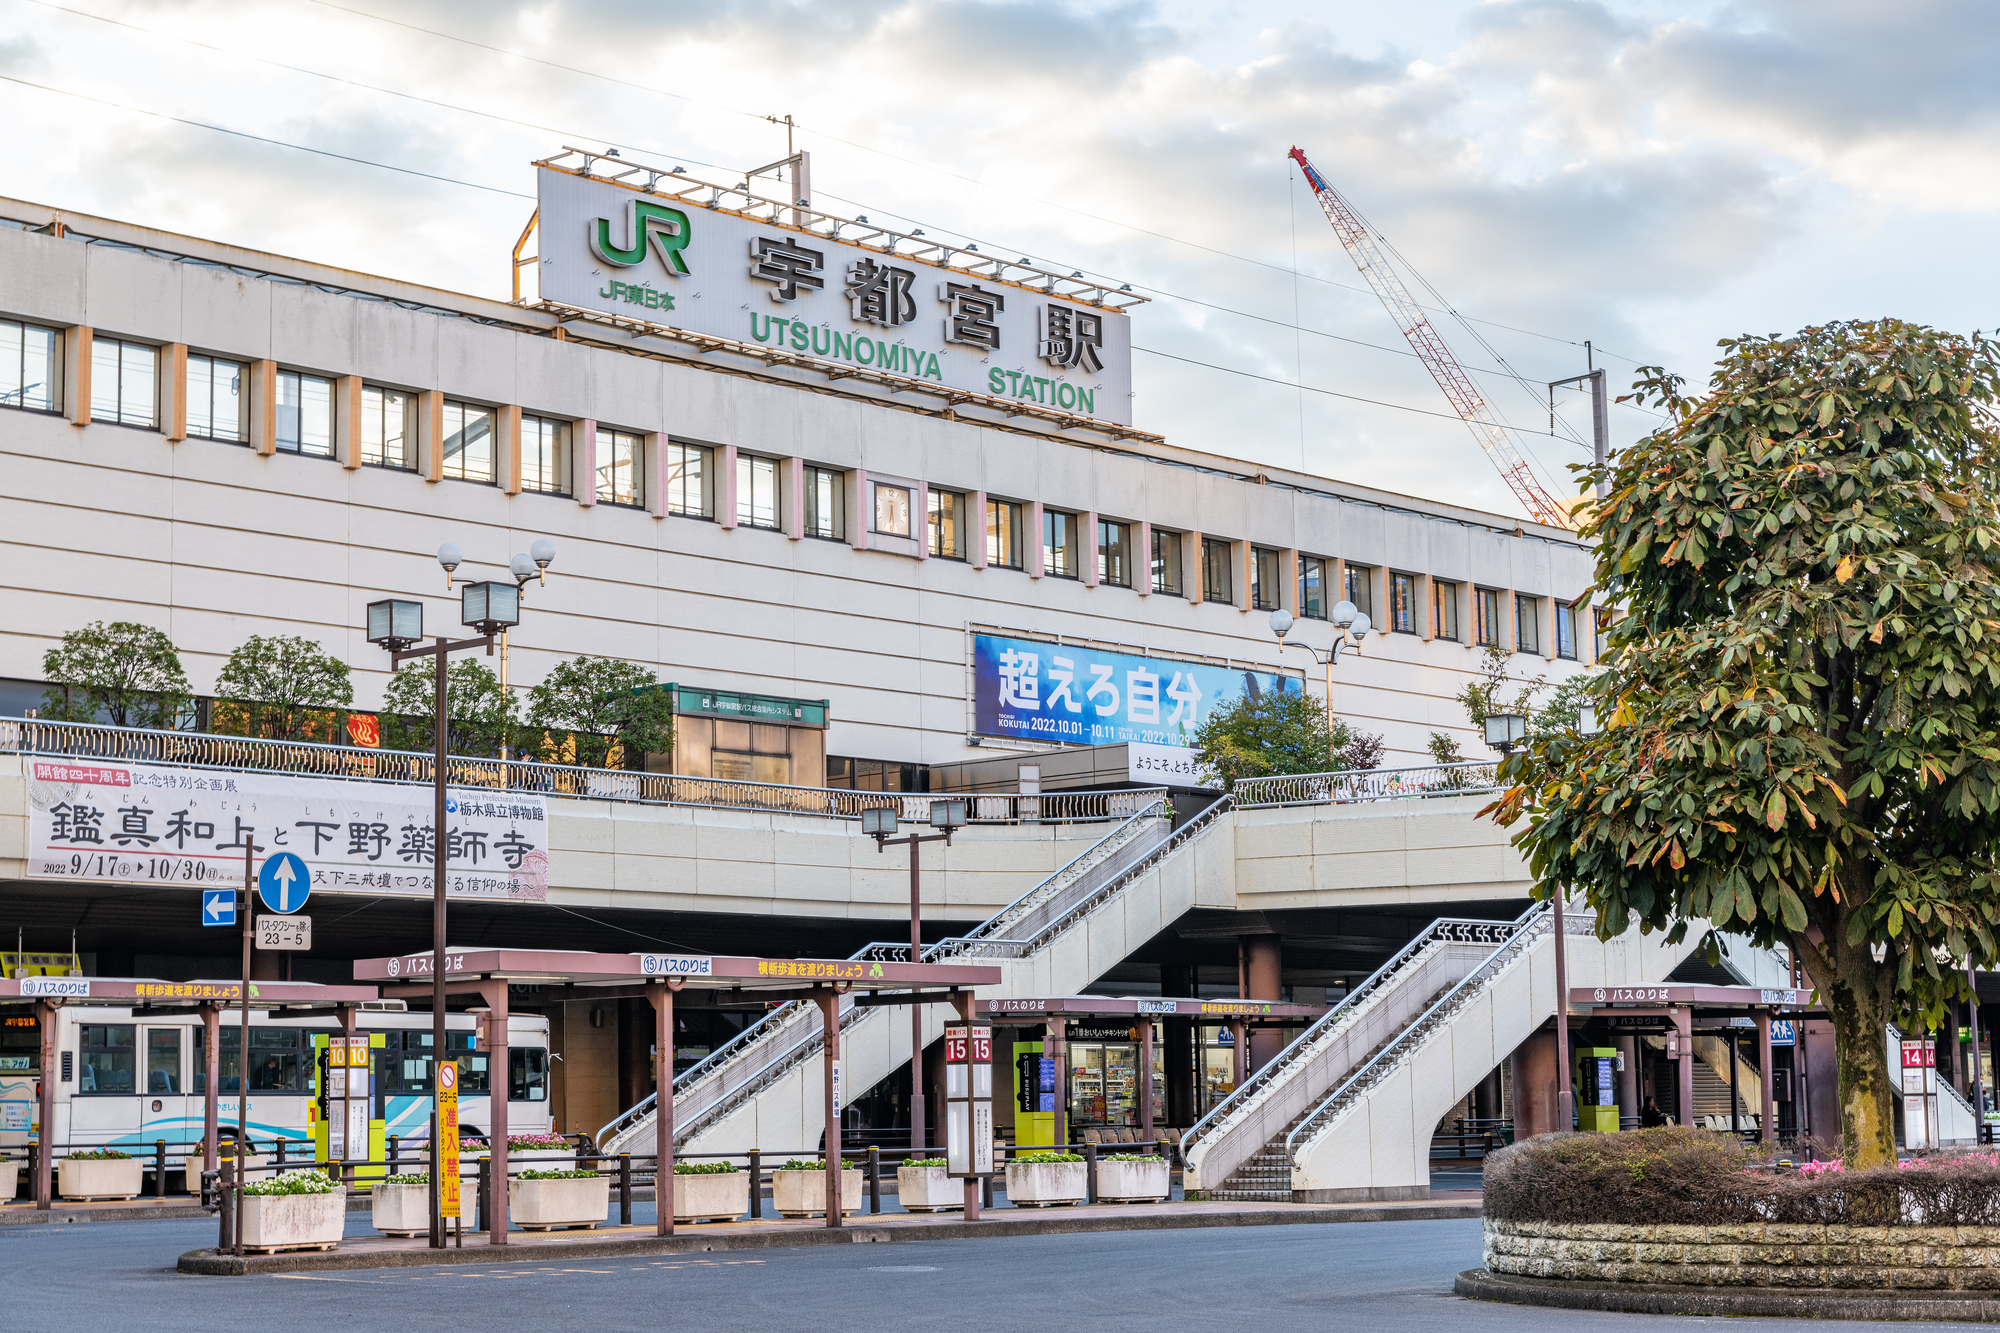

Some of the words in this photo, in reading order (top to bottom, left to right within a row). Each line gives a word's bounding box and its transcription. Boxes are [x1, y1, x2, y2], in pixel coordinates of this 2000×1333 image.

[589, 199, 692, 277] JR
[600, 280, 675, 312] JR東日本
[750, 236, 1106, 374] 宇都宮駅
[750, 311, 943, 381] UTSUNOMIYA
[988, 365, 1095, 413] STATION
[998, 719, 1030, 730] KOKUTAI
[1118, 732, 1140, 742] TAIKAI
[1142, 730, 1190, 747] 2022.10.29
[36, 764, 130, 785] 開館四十周年
[132, 772, 238, 792] 記念特別企画展
[457, 792, 480, 803] Tochigi
[481, 794, 514, 804] Prefectural
[516, 796, 542, 806] Museum
[460, 801, 544, 822] 栃木県立博物館
[44, 863, 66, 874] 2022
[658, 958, 710, 973] バスのりば
[758, 961, 864, 978] 横断歩道を渡りましょう
[38, 982, 88, 994] バスのりば
[135, 983, 240, 998] 横断歩道を渡りましょう
[1613, 989, 1668, 1000] バスのりば
[1003, 1000, 1045, 1010] バスのりば
[1147, 1003, 1175, 1012] バスのりば
[1201, 1003, 1260, 1013] 横断歩道を渡りましょう
[332, 1048, 345, 1064] 10
[351, 1048, 366, 1064] 10
[948, 1040, 966, 1059] 15
[974, 1040, 990, 1059] 15
[1926, 1050, 1934, 1064] 14
[1904, 1050, 1920, 1065] 14
[440, 1092, 457, 1103] 23-5
[446, 1108, 458, 1202] 進入禁止
